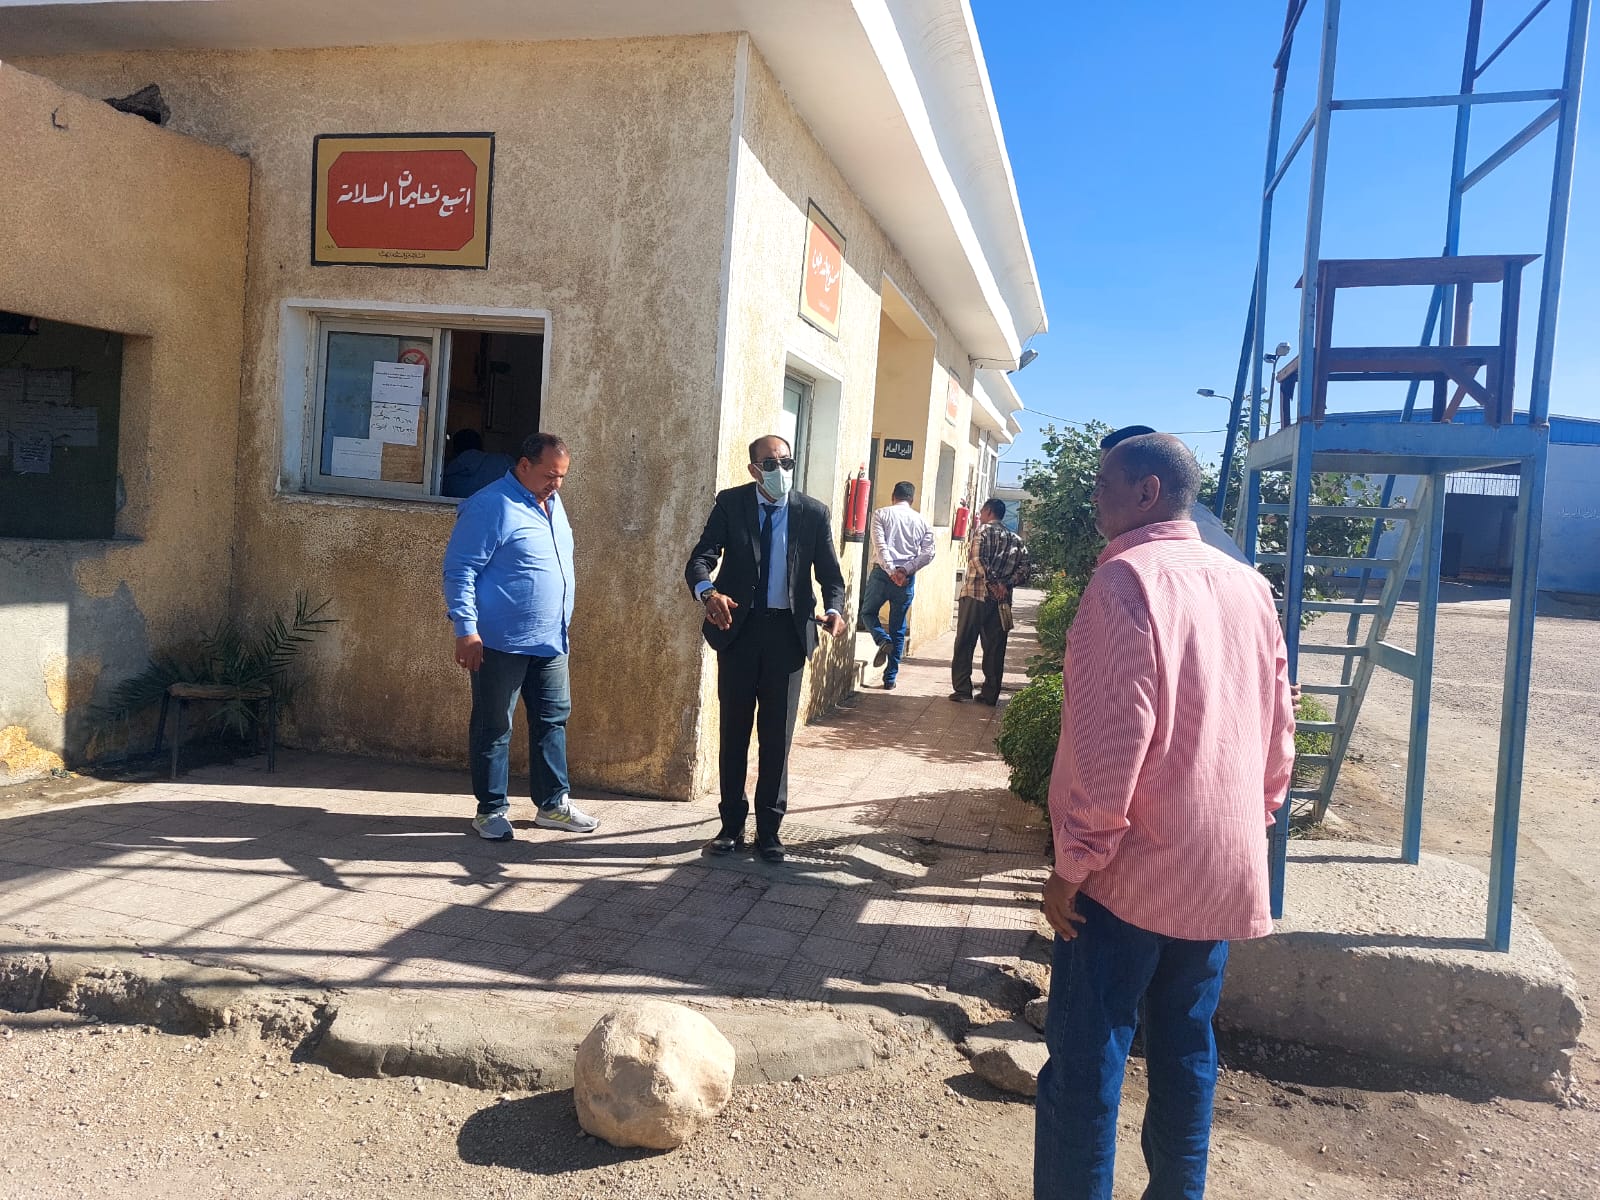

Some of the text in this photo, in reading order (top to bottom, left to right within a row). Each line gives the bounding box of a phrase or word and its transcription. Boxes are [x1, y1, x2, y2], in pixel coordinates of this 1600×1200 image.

[336, 181, 394, 209] السلامة
[397, 170, 440, 209] تعليمات
[884, 442, 900, 457] العام
